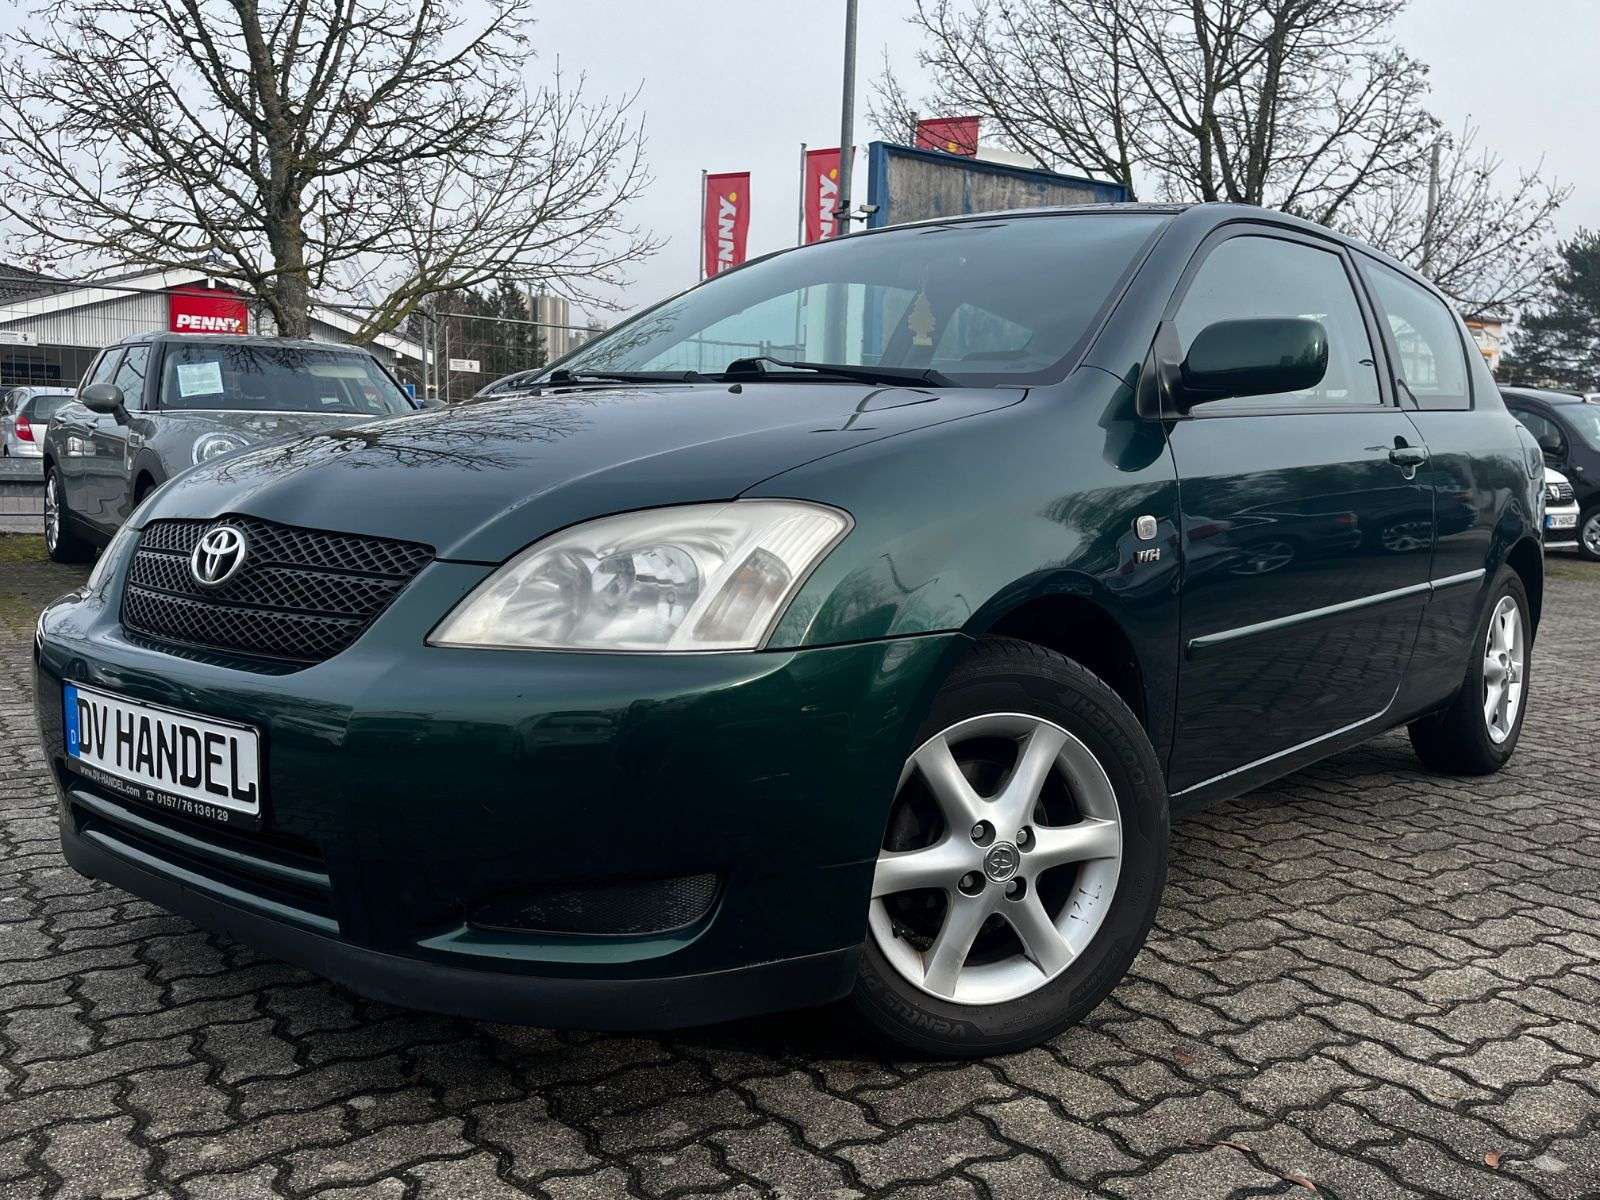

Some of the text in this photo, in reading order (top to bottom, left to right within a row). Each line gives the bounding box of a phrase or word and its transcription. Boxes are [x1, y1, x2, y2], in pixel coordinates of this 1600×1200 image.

[820, 174, 838, 240] NNY
[176, 314, 240, 333] PENNY
[71, 729, 76, 744] D
[78, 698, 256, 803] DV HANDEL
